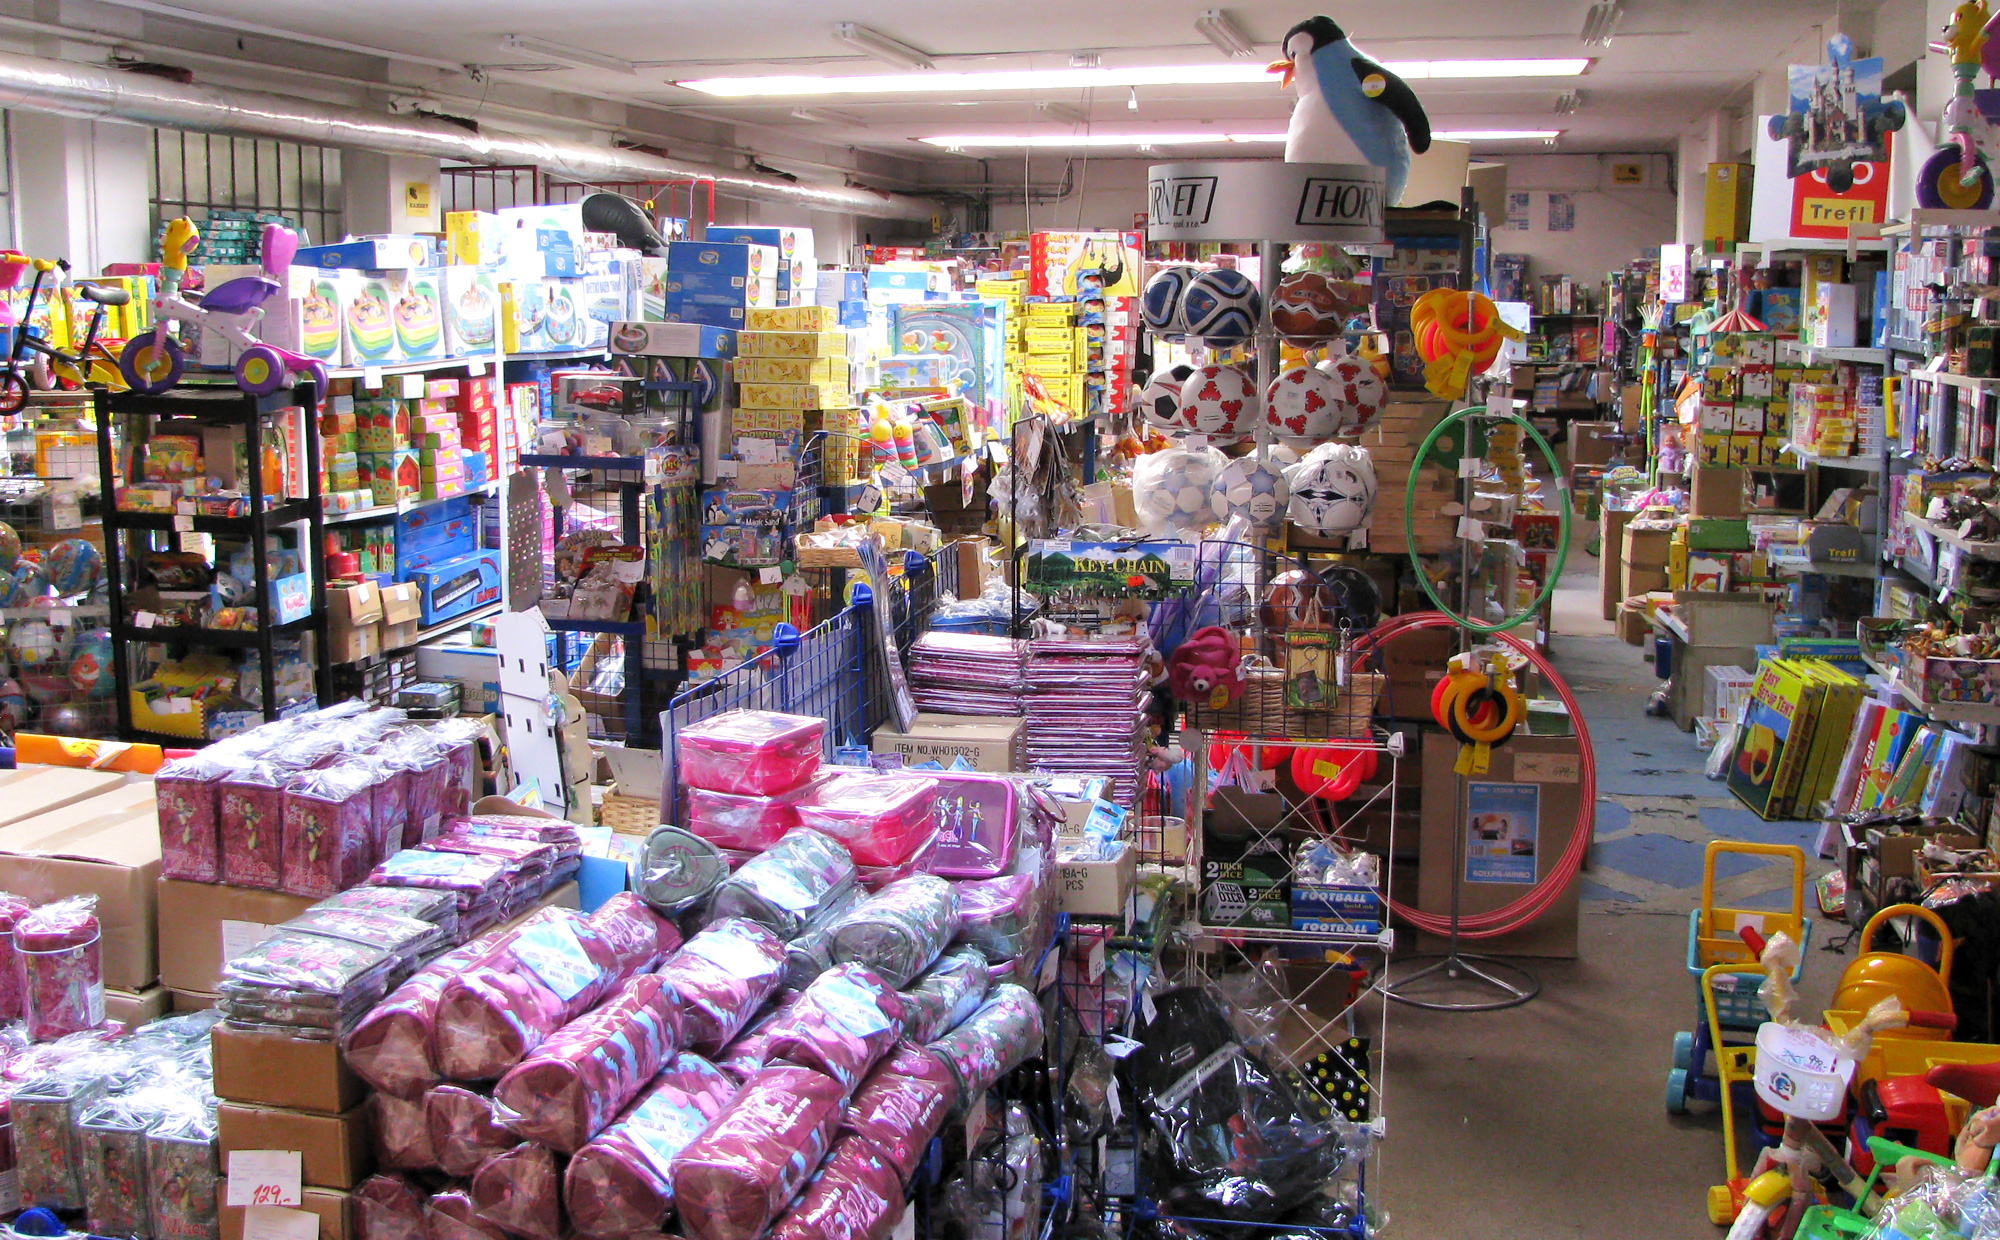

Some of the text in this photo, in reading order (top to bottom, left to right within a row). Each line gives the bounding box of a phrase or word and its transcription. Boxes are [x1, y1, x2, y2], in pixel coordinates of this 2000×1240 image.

[1811, 204, 1865, 221] Trefl
[1828, 548, 1857, 557] Trefl
[1073, 556, 1166, 574] KEY-CHAIN
[894, 743, 914, 752] ITEM
[1205, 861, 1220, 878] 2
[1219, 862, 1243, 871] TRICK
[1220, 871, 1243, 879] DICE
[1065, 880, 1084, 890] PCS
[1248, 887, 1258, 899] 2
[1300, 891, 1367, 903] FOOTBALL
[1301, 922, 1368, 934] FOOTBALL
[253, 1184, 292, 1205] 129,-
